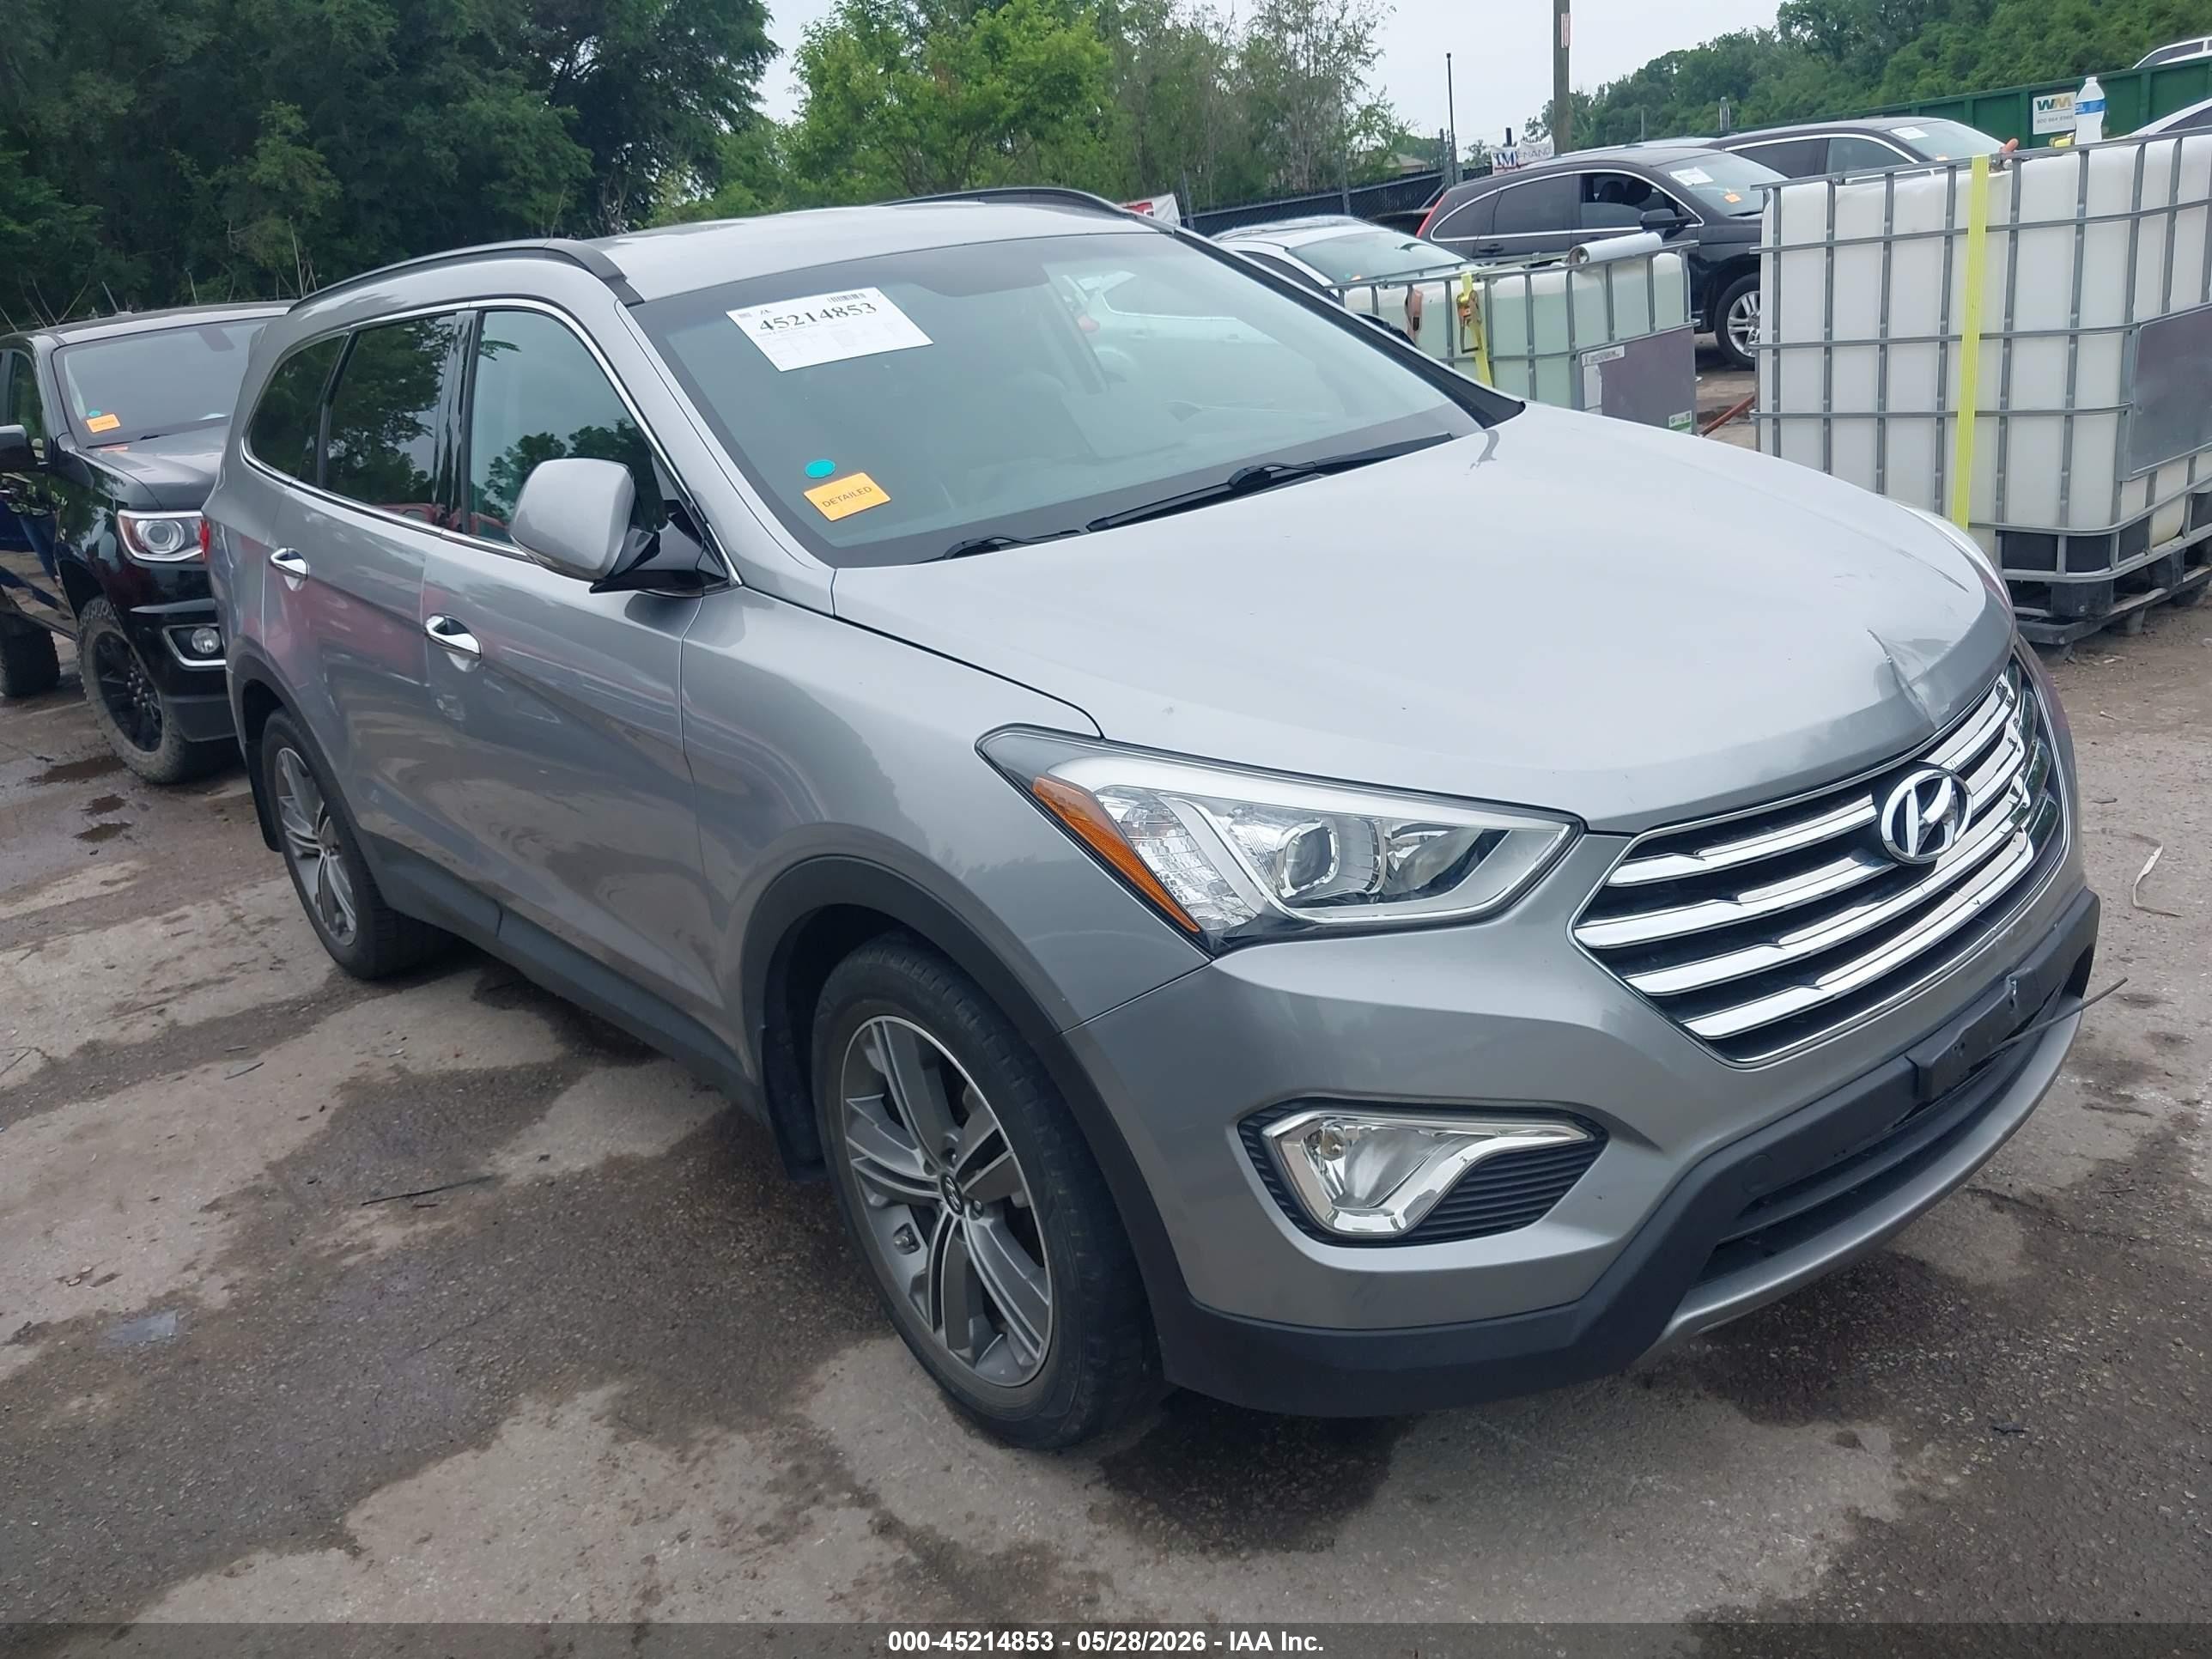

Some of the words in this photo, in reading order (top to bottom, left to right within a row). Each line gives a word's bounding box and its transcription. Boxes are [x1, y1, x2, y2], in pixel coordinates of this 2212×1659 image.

[2036, 96, 2072, 111] WM
[759, 302, 877, 331] 45214853
[822, 486, 872, 507] DETAILED
